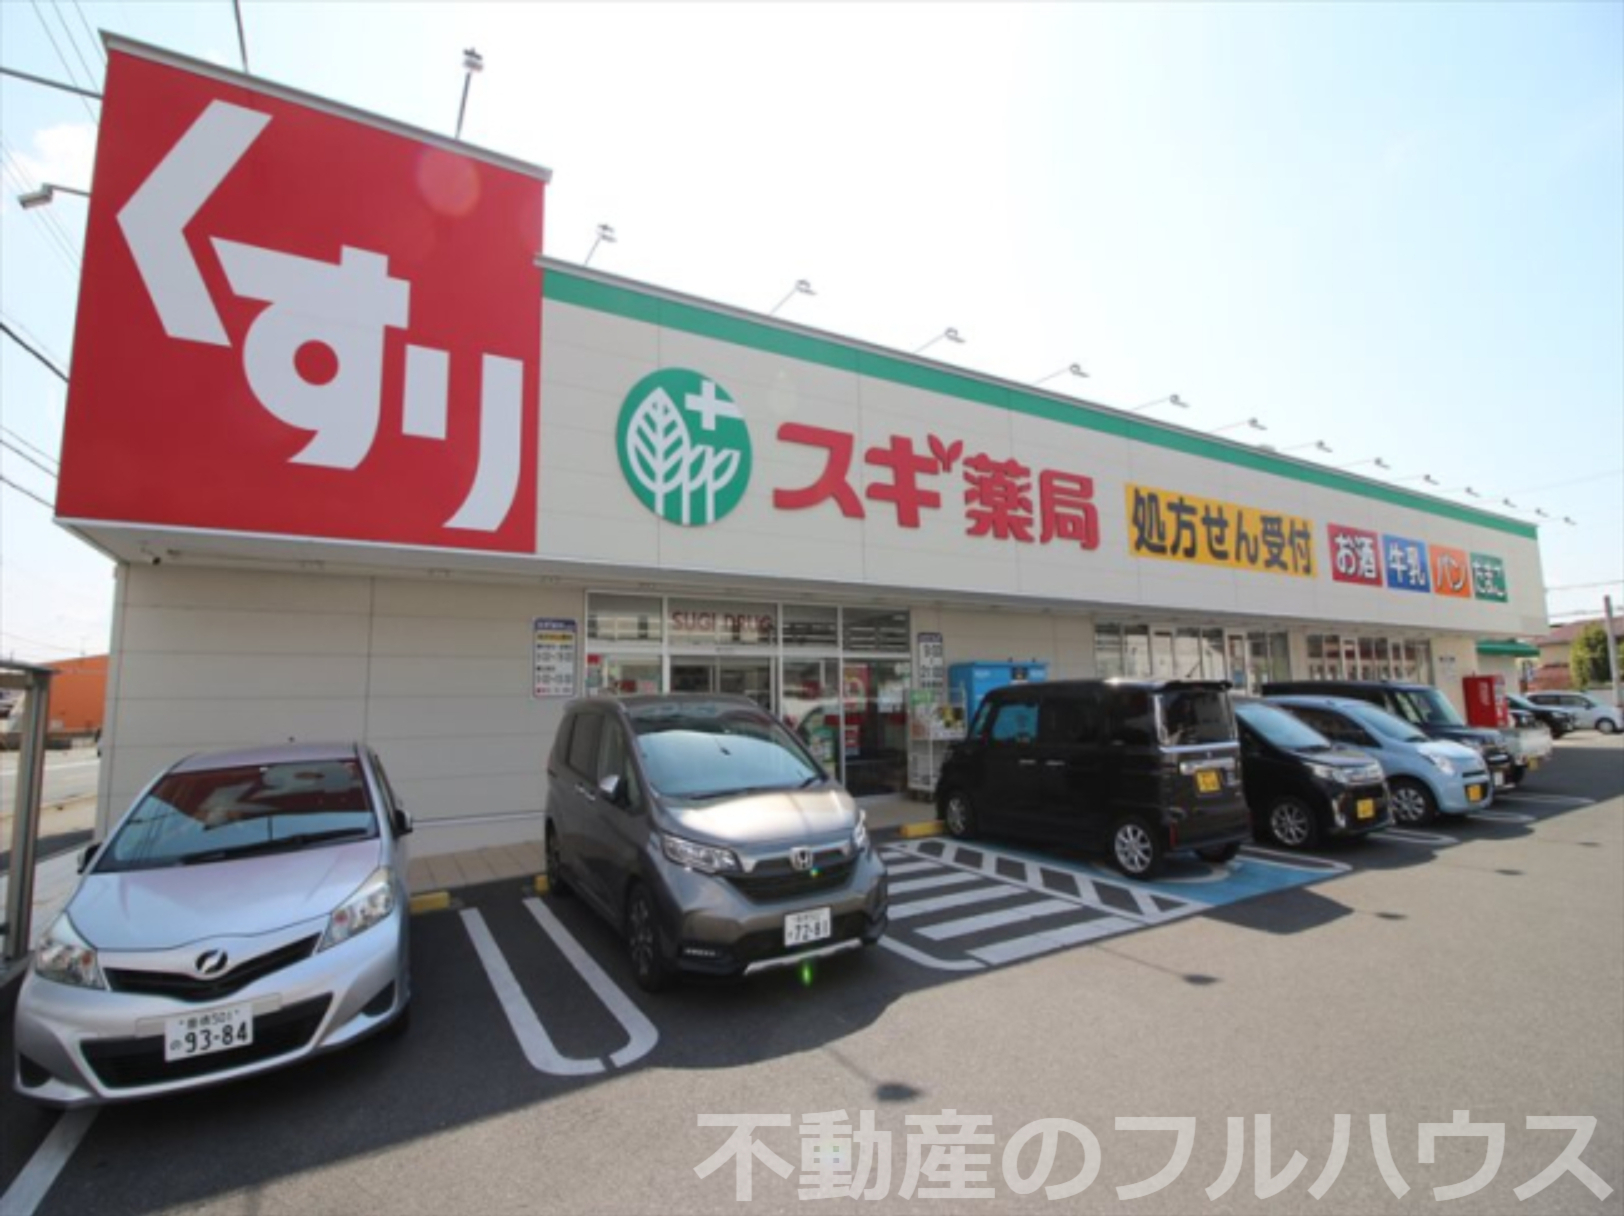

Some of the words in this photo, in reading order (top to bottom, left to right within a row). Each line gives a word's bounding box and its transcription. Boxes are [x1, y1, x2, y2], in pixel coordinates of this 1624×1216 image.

[116, 98, 523, 532] くすり
[773, 422, 1099, 550] スギ薬局
[1131, 488, 1312, 575] 処方せん受付
[1334, 534, 1377, 579] お酒
[1387, 543, 1427, 586] 牛乳
[1435, 553, 1469, 591] パン
[672, 611, 716, 632] SUGI
[184, 1020, 248, 1053] 93-84
